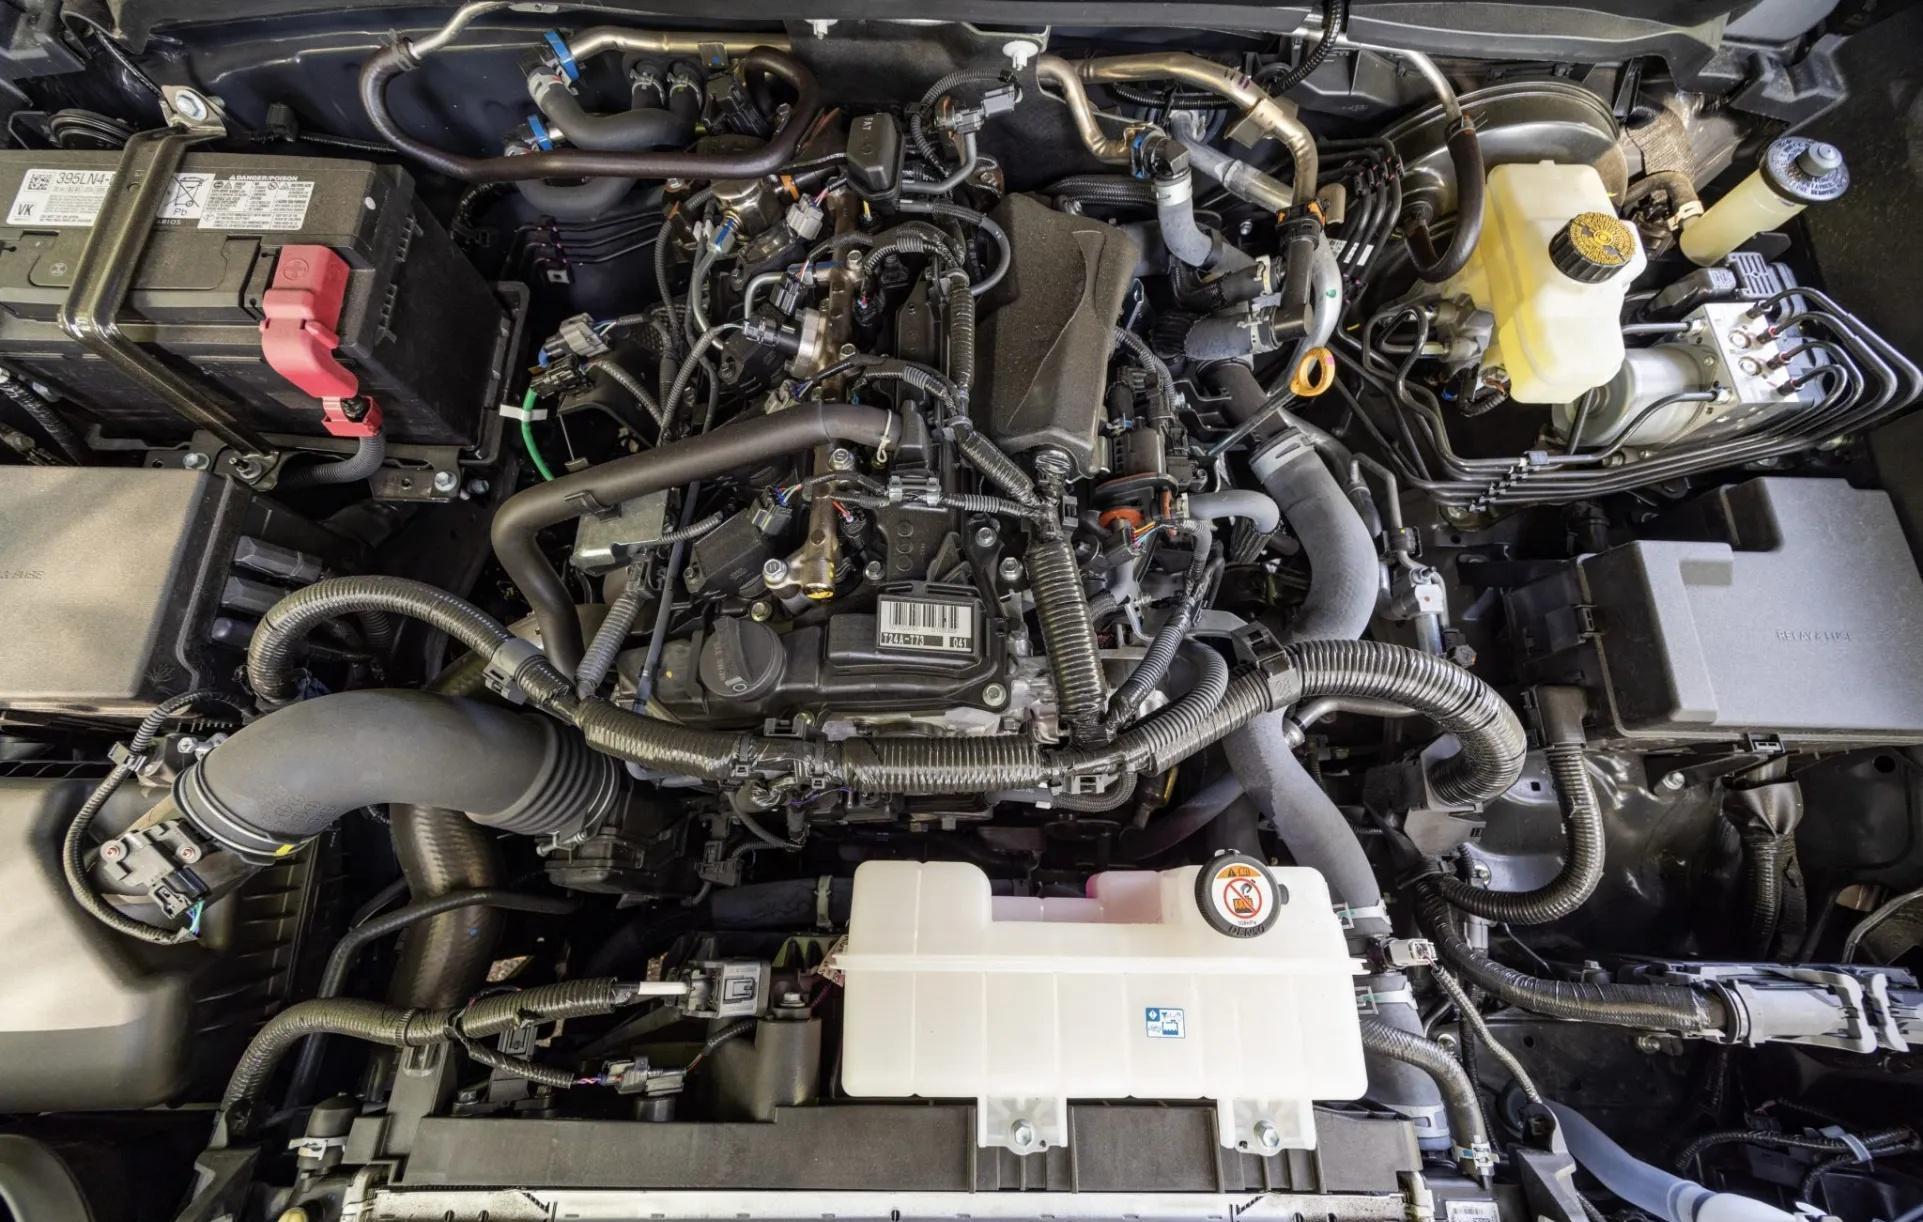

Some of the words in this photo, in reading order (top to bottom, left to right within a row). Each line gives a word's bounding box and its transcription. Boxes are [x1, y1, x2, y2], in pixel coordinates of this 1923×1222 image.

[56, 172, 112, 185] 395LN4-
[17, 203, 34, 216] VK
[173, 207, 188, 216] Pb
[883, 632, 925, 646] T24A-T73
[952, 637, 968, 648] 041
